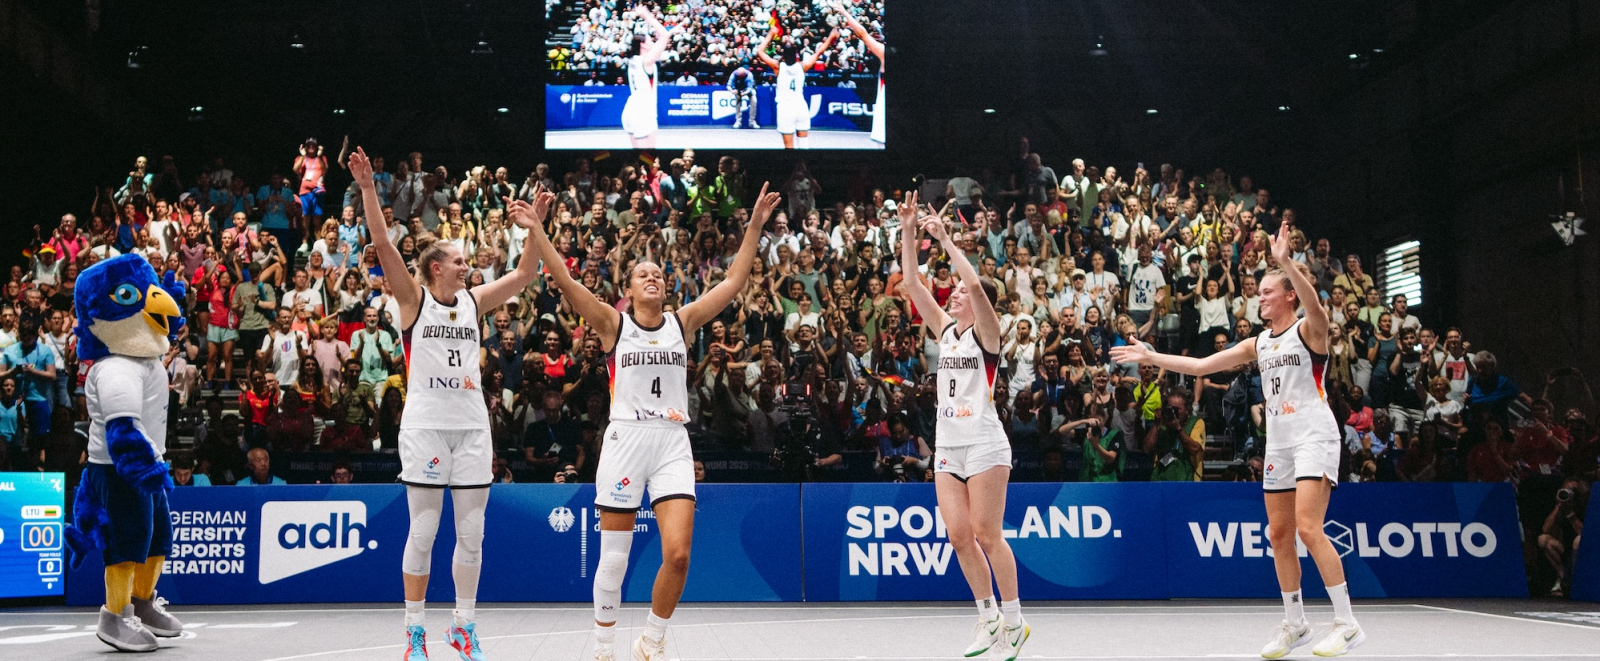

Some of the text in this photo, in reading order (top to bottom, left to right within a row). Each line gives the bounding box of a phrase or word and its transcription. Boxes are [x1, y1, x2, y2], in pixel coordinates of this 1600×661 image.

[447, 348, 462, 368] 21
[621, 350, 686, 368] DEUTSCHLAND
[429, 377, 460, 389] ING
[650, 376, 662, 399] 4
[949, 378, 957, 398] 8
[25, 508, 40, 516] LTU
[170, 510, 247, 525] GERMAN
[846, 505, 1122, 539] SPOAND.
[28, 526, 55, 547] 00
[1355, 521, 1498, 558] LOTTO
[170, 543, 246, 558] SPORTS
[848, 542, 954, 576] NRW
[46, 561, 54, 572] 0
